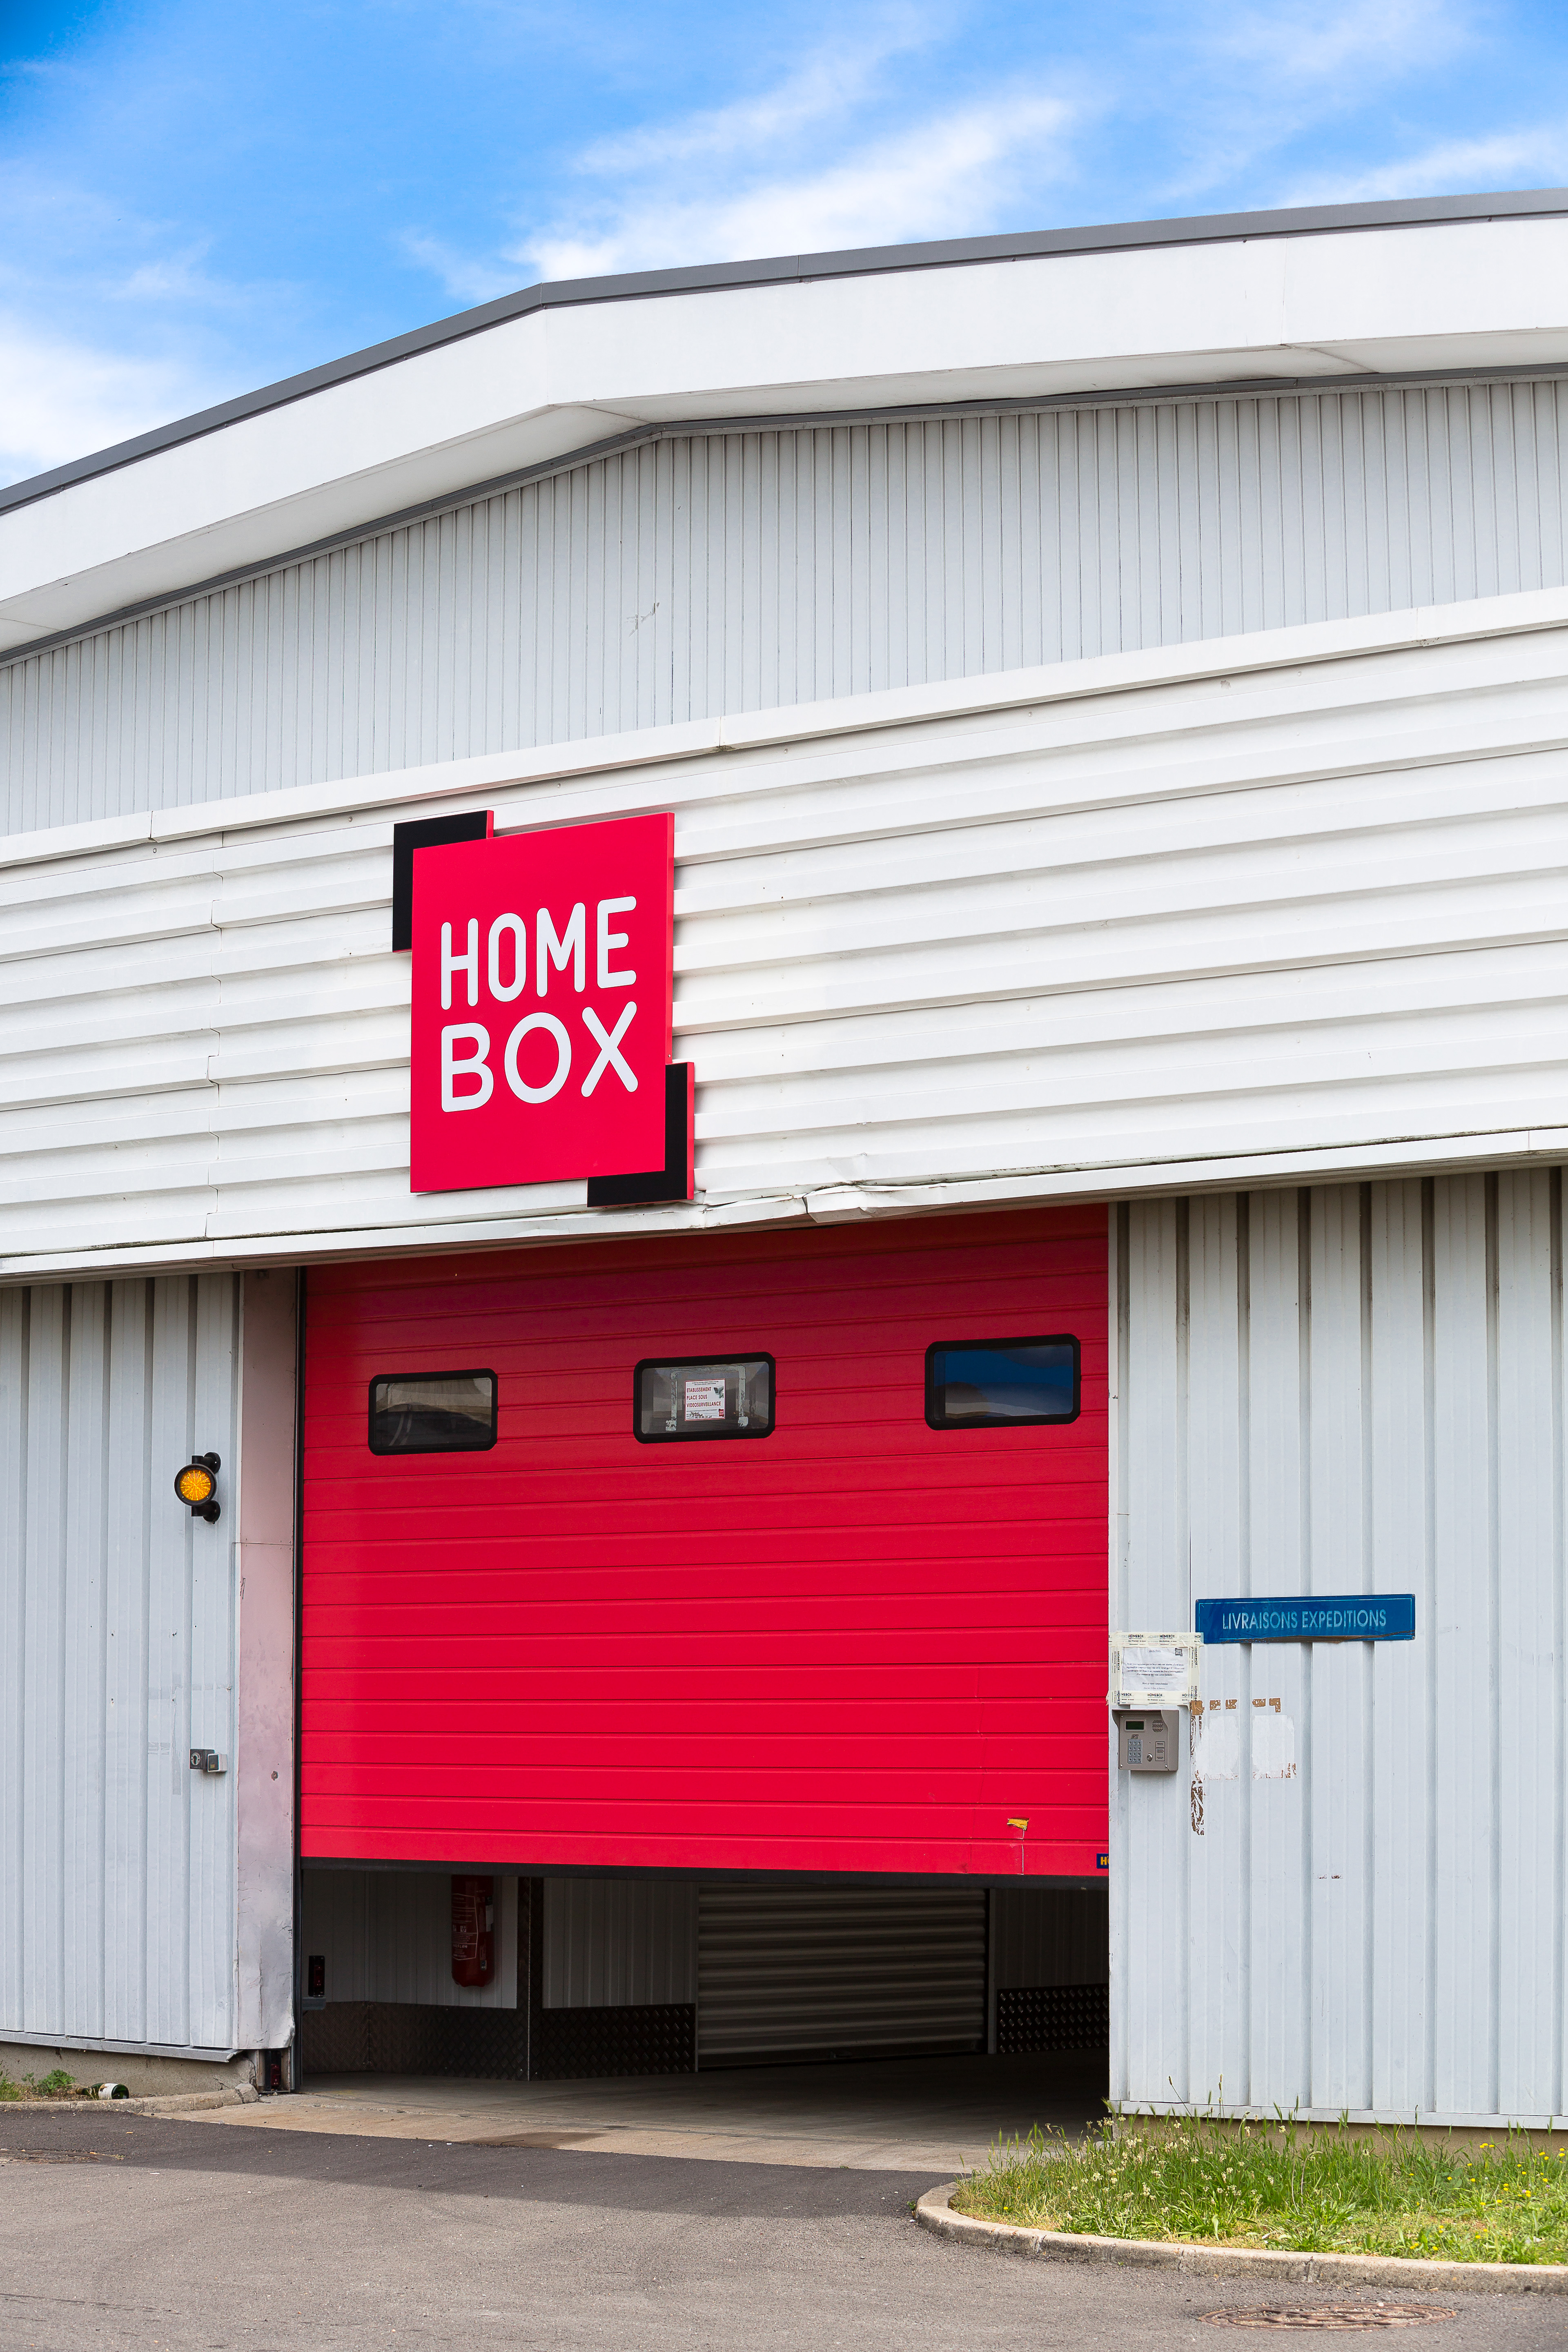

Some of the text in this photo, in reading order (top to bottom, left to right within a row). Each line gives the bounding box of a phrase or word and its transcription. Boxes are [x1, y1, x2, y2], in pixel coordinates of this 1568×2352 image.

[441, 896, 637, 1010] HOME
[441, 1001, 637, 1112] BOX
[1223, 1609, 1386, 1630] LIVRAISONS EXPEDITIONS
